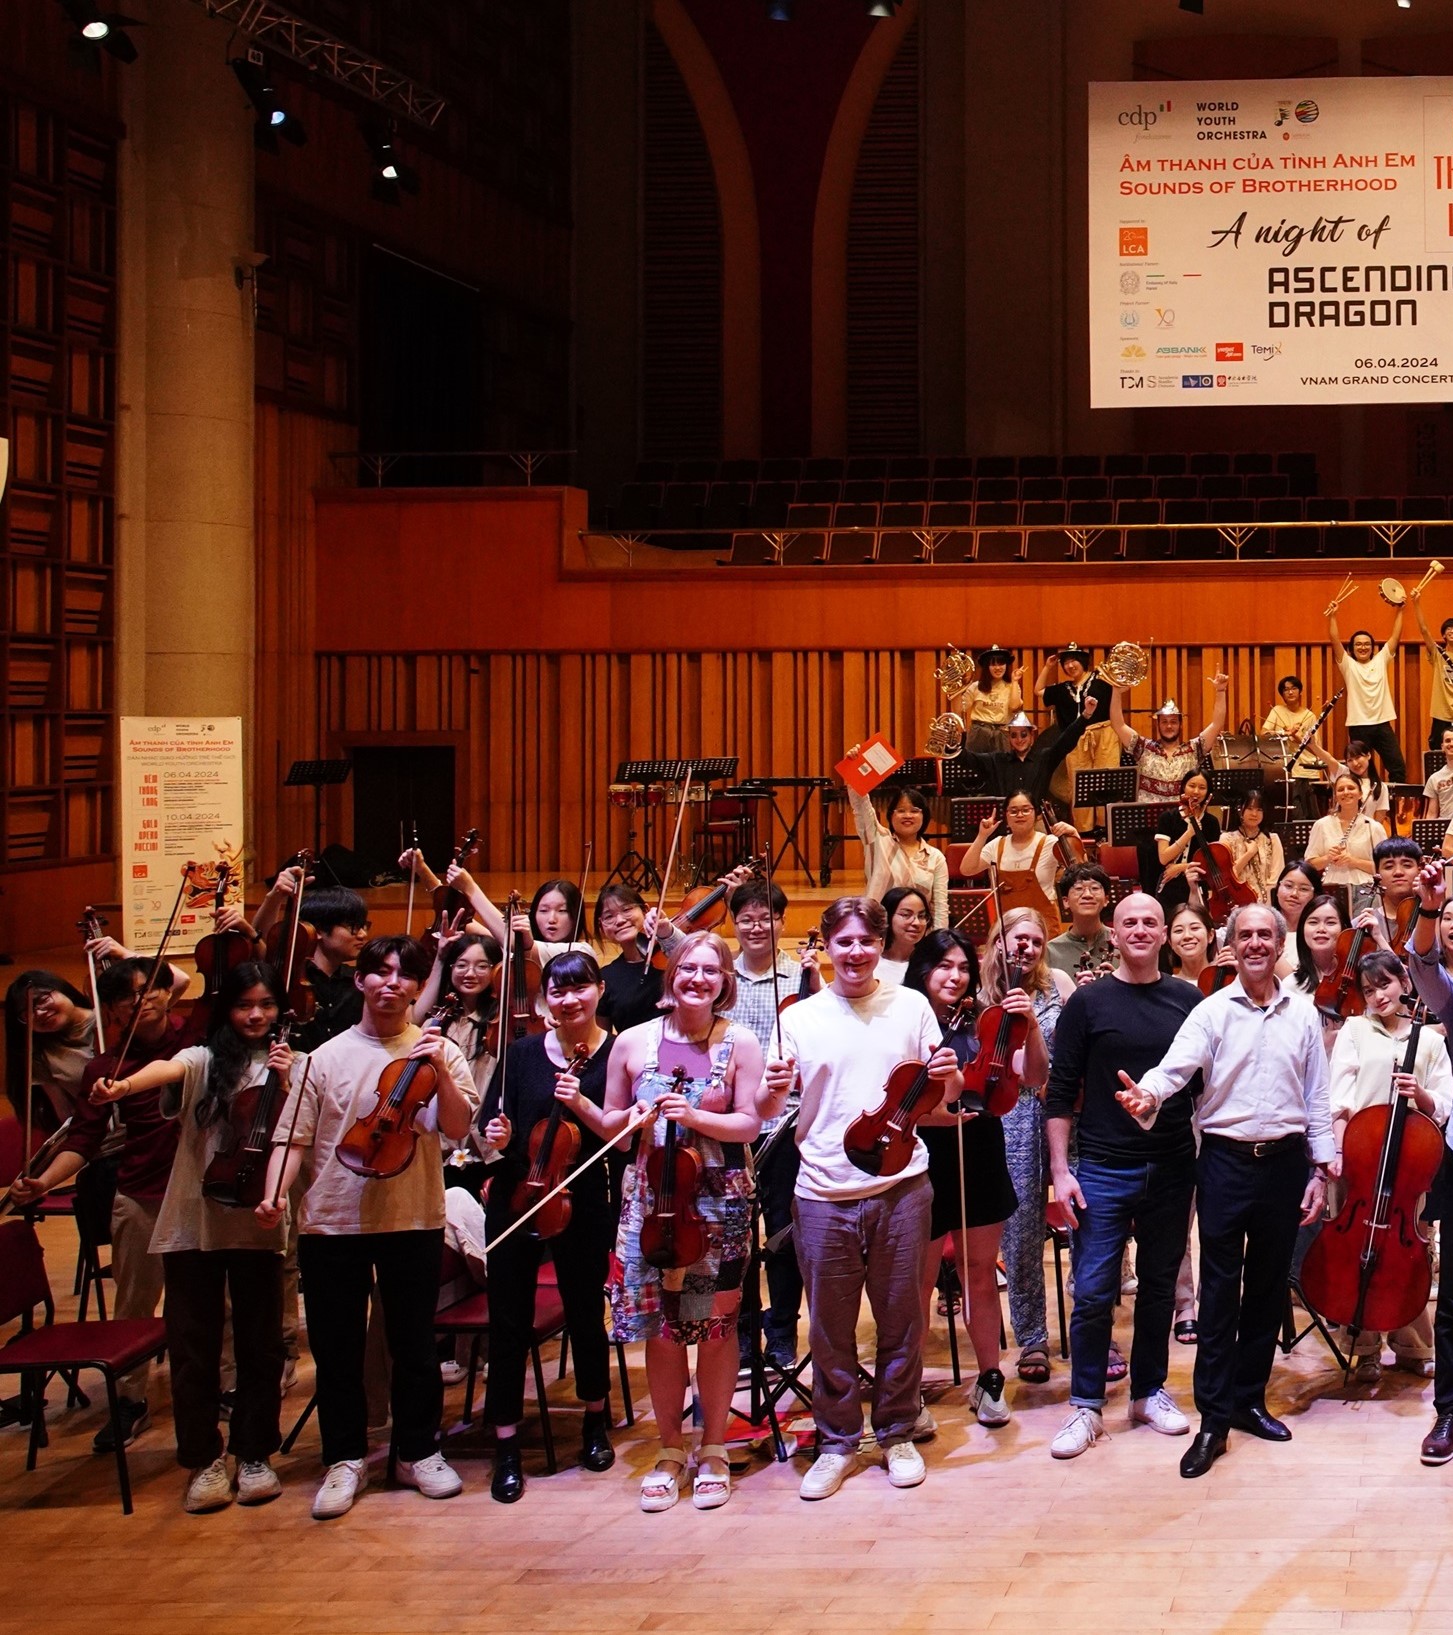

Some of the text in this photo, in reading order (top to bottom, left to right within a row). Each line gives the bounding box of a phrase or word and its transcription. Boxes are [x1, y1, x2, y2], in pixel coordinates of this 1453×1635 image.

[1196, 102, 1239, 111] WORLD
[1118, 105, 1157, 130] cdp
[1196, 117, 1236, 126] YOUTH
[1196, 131, 1267, 141] ORCHESTRA
[1206, 211, 1391, 257] A night of
[1123, 244, 1145, 253] LCA
[1268, 299, 1417, 328] DRAGON
[1156, 346, 1206, 354] ABBANK
[1354, 357, 1439, 369] 06.04.2024
[1300, 376, 1339, 386] VNAM
[1342, 375, 1389, 385] GRAND
